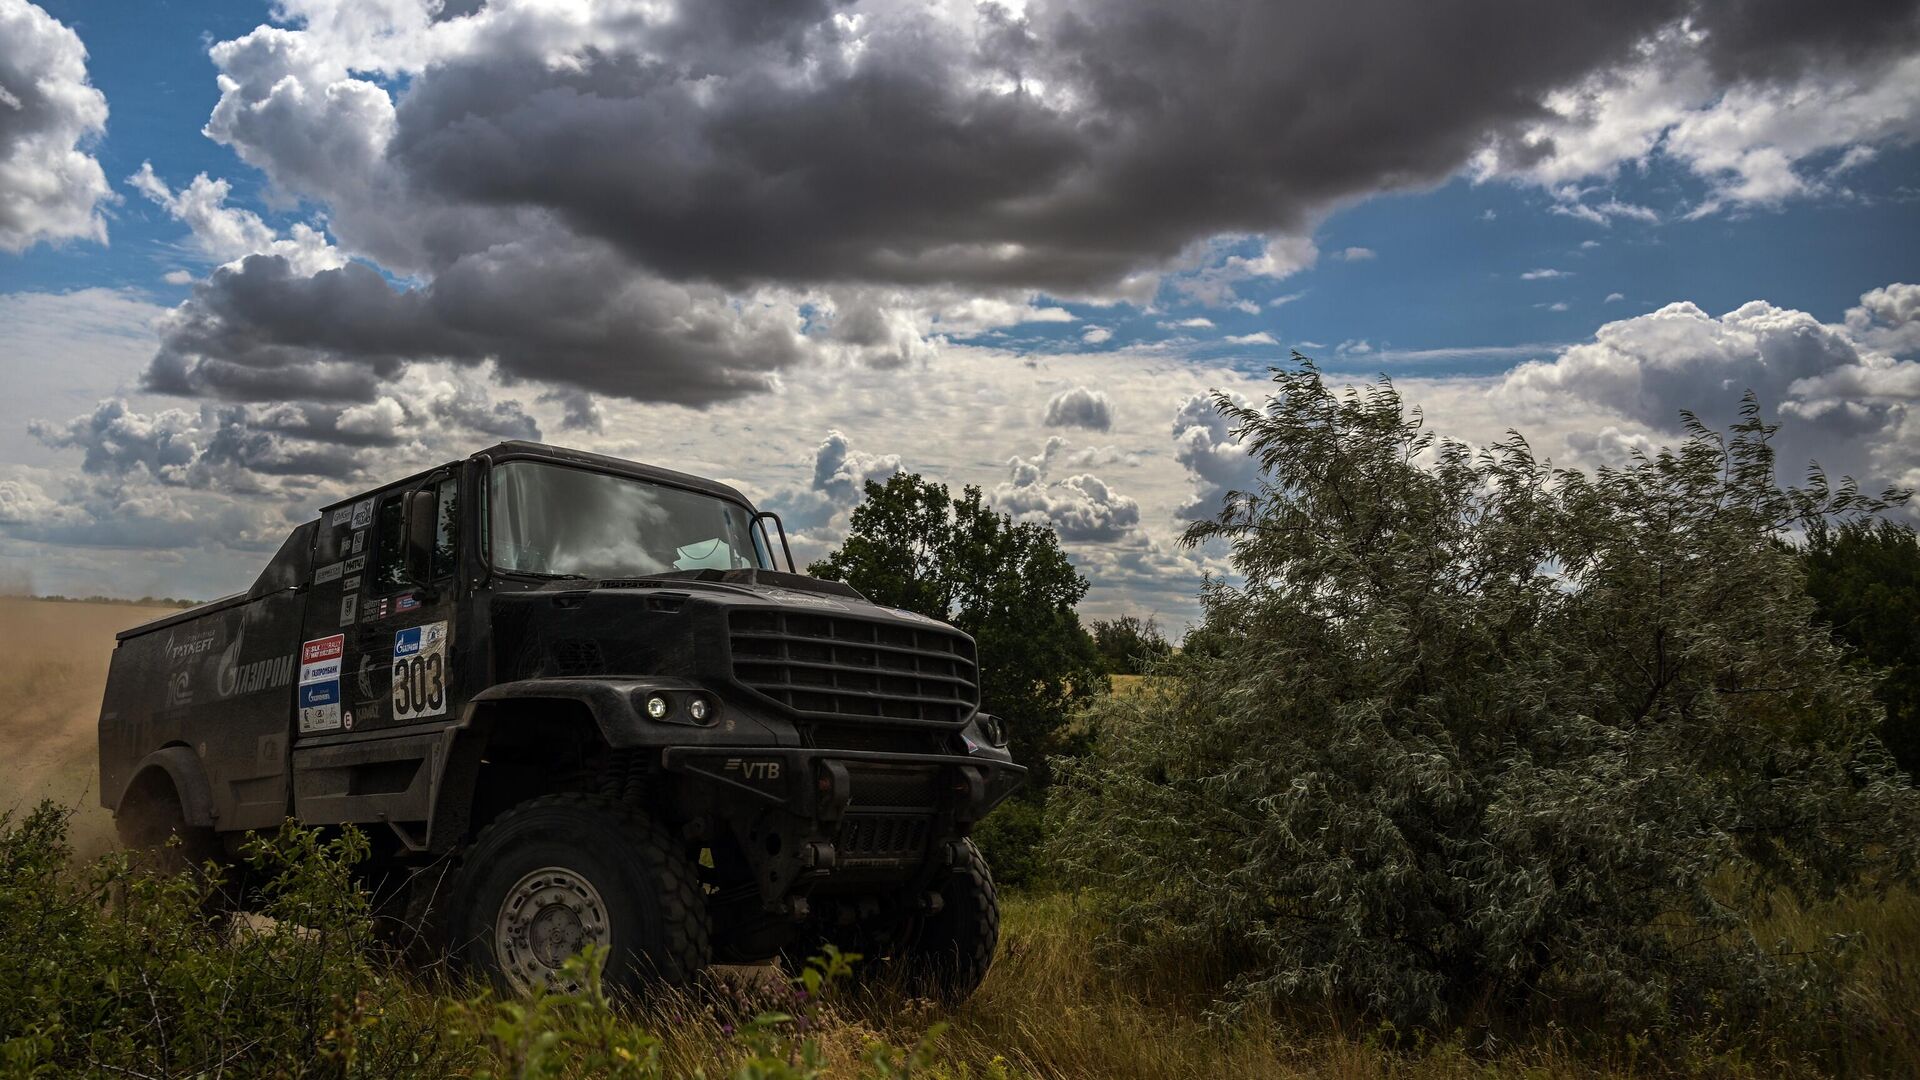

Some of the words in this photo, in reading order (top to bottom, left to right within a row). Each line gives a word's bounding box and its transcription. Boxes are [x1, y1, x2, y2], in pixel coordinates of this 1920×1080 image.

[235, 654, 294, 695] ГАЗПРОМ
[394, 652, 443, 715] 303
[742, 762, 780, 779] VTB
